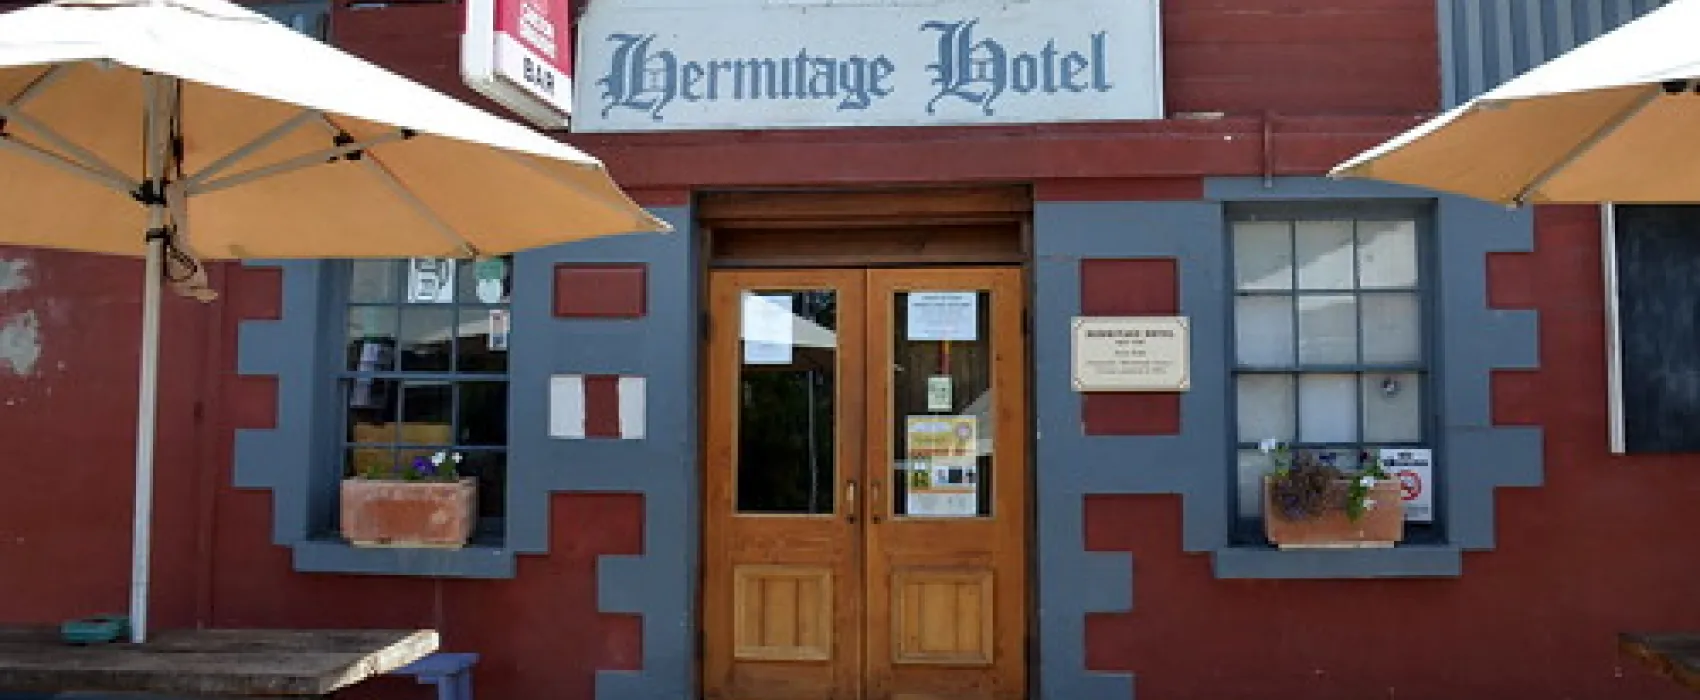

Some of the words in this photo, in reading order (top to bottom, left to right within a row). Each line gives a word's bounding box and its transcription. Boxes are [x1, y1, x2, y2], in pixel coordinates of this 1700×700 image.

[523, 57, 555, 95] BAR
[597, 33, 894, 120] Hermitage
[920, 17, 1113, 117] Hotel
